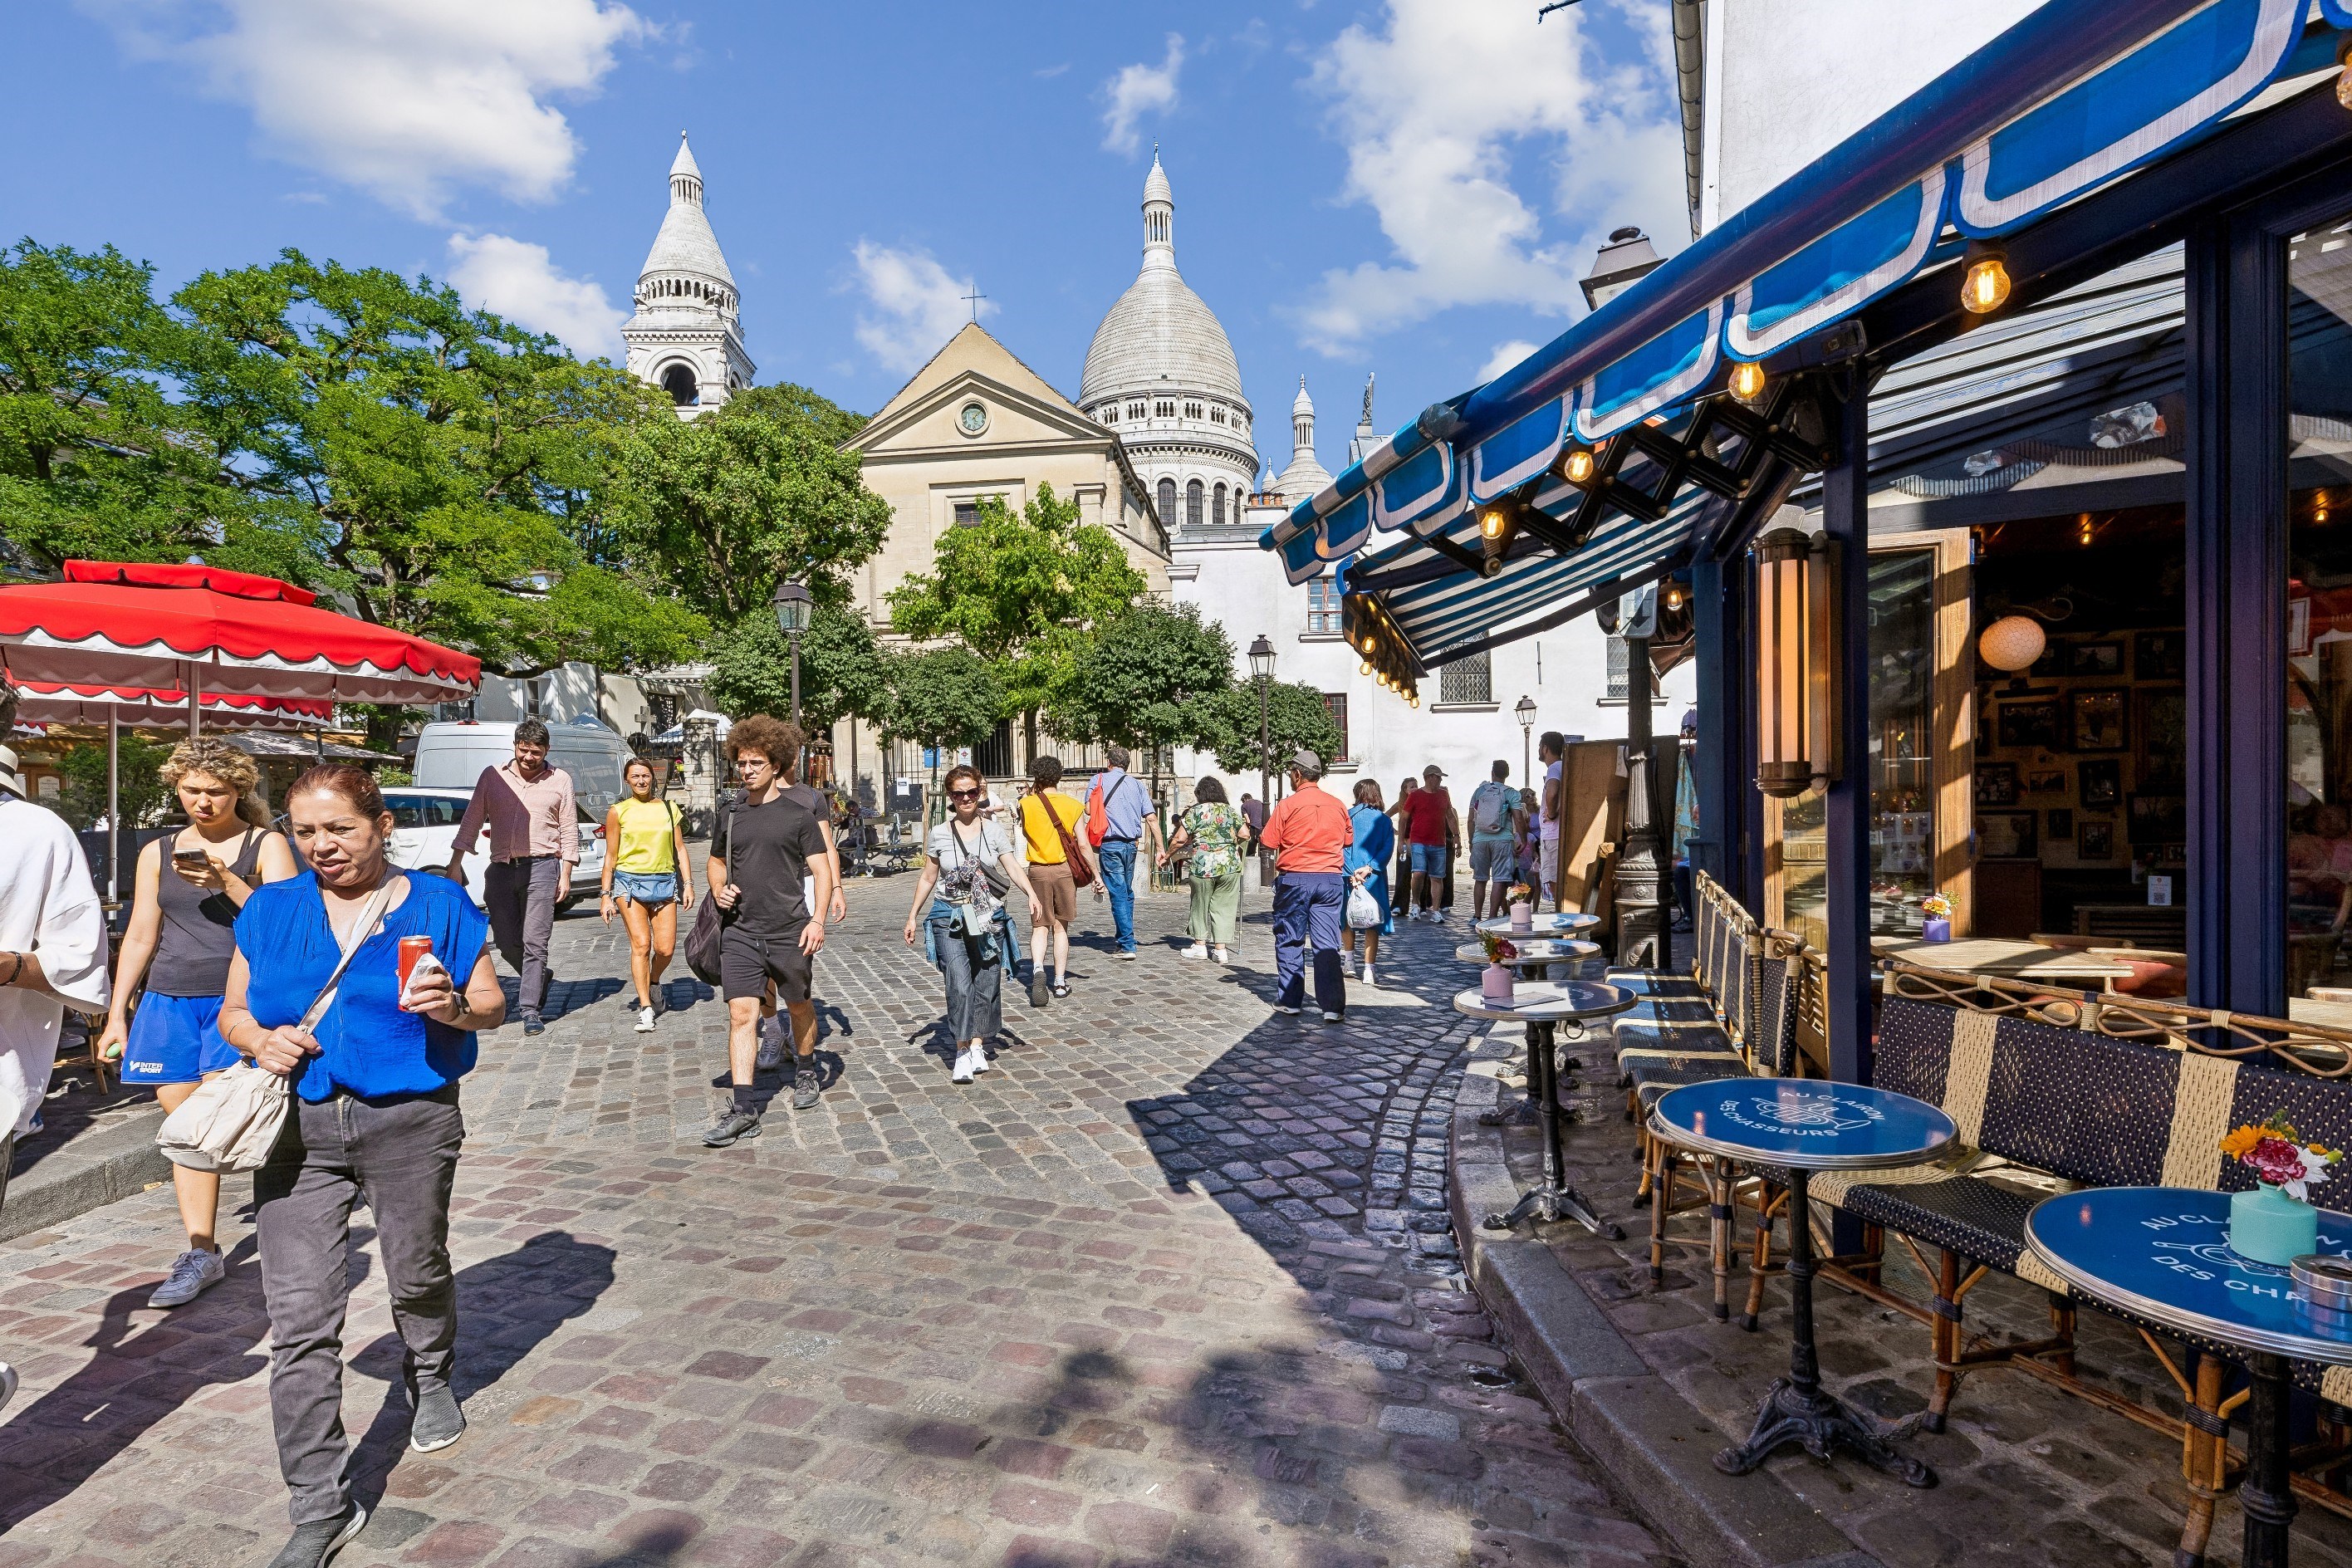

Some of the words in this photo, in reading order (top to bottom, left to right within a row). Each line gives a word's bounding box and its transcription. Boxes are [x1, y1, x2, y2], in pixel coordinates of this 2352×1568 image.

[1719, 1100, 1741, 1112] DES
[1816, 1095, 1885, 1120] CLAIRON
[1722, 1111, 1840, 1136] CHASSEURS
[2140, 1216, 2178, 1230] AU
[2149, 1256, 2216, 1280] DES
